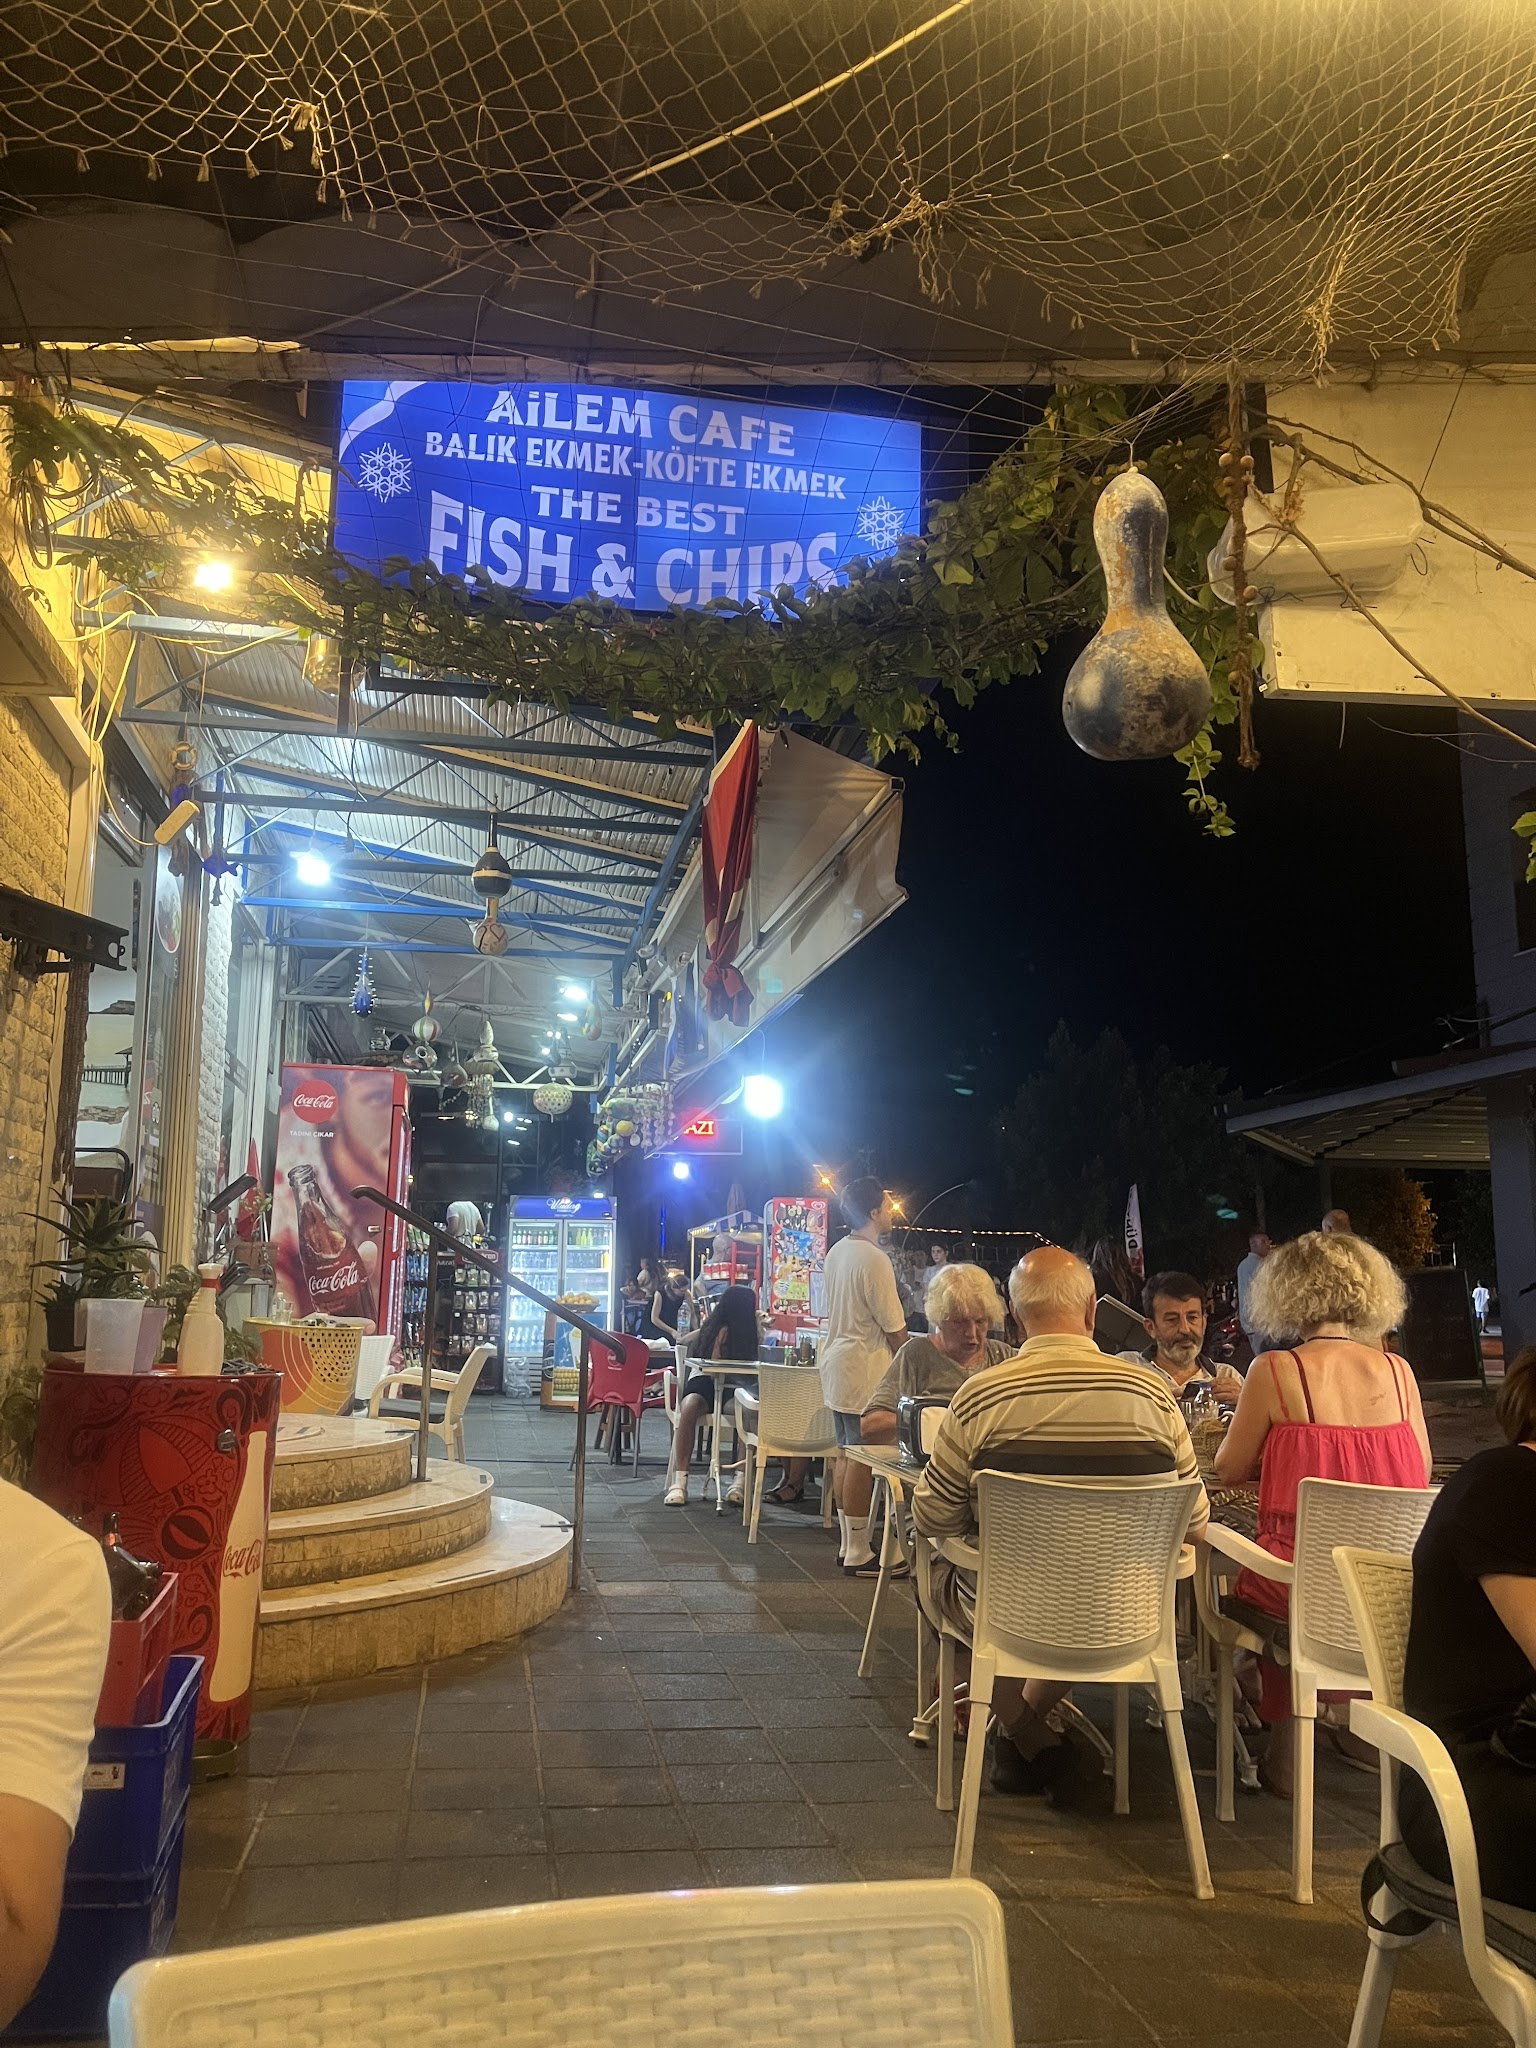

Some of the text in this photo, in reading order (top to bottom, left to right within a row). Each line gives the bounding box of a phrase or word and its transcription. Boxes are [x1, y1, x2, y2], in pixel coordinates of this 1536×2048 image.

[668, 404, 796, 457] CAFE
[425, 431, 847, 499] BALIK EKMEK-KÖFTE EKMEK
[531, 485, 745, 535] THE BEST
[428, 490, 840, 606] FISH & CHIPS
[293, 1093, 337, 1109] Coca-Cola
[308, 1261, 359, 1295] Coca-Cola
